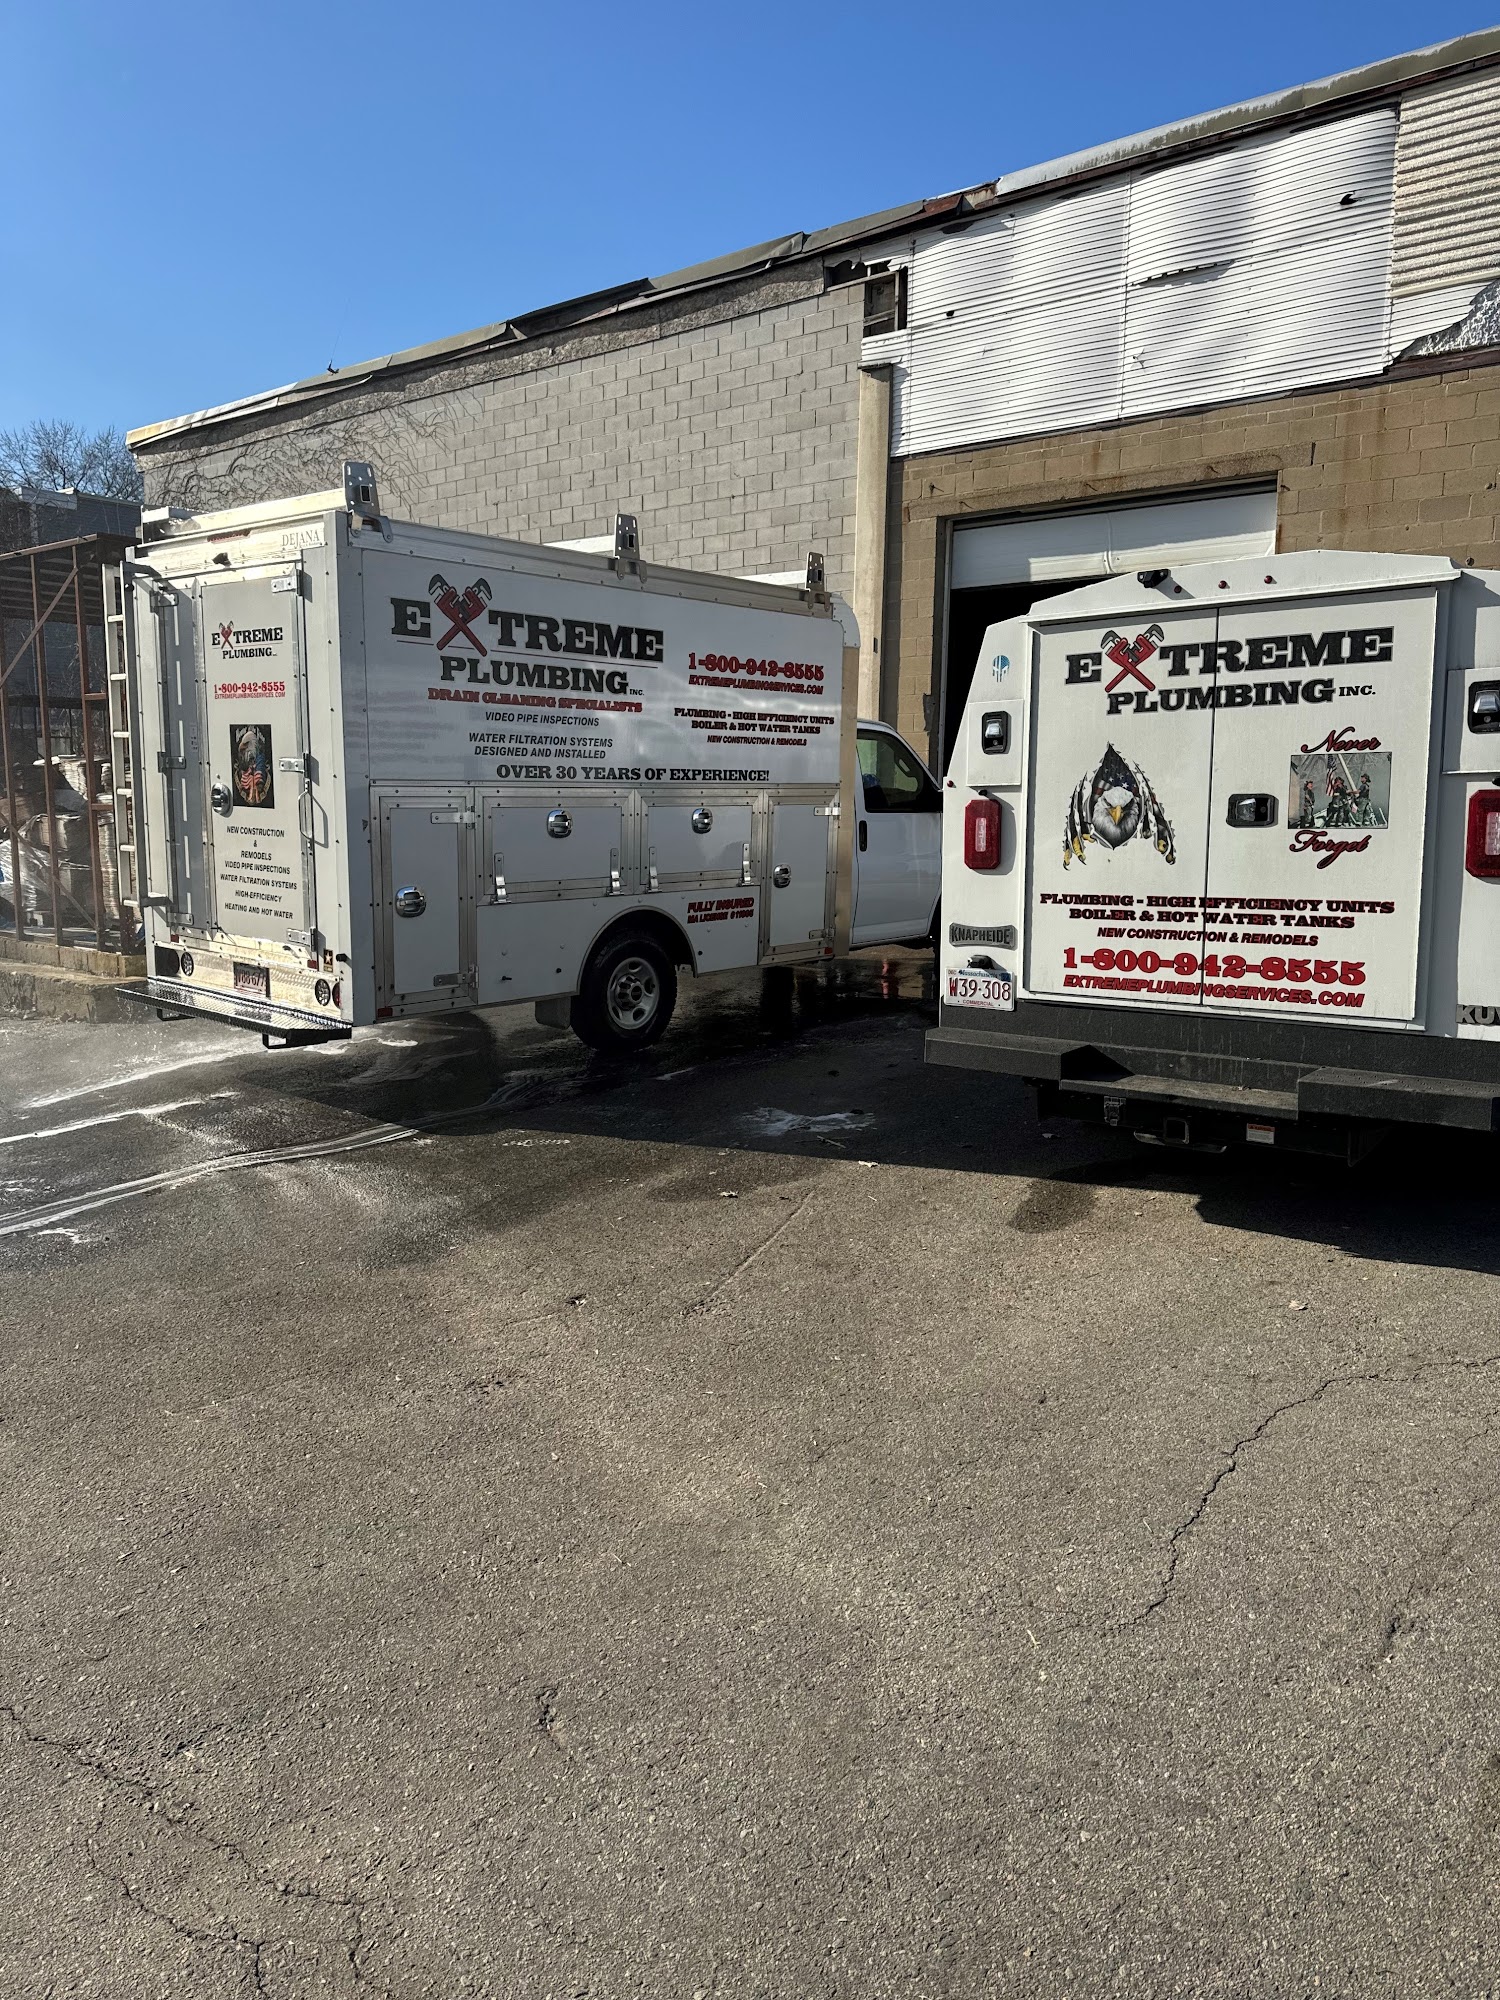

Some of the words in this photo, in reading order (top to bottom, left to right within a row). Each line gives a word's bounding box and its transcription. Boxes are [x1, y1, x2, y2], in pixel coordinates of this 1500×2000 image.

[282, 529, 320, 549] DEJANA
[222, 647, 272, 659] PLUMBING
[688, 652, 824, 681] 1-800-942-8555
[440, 656, 628, 695] PLUMBING
[629, 688, 645, 697] INC.
[688, 675, 823, 695] EXTREMEPLUMBINGSERVICES.COM
[214, 681, 285, 694] 1-800-942-8555
[215, 691, 285, 700] EXTREMEPLUMBINGSERVICES.COM
[1106, 678, 1336, 715] PLUMBING
[1338, 684, 1376, 697] INC.
[428, 688, 480, 703] DRAIN
[481, 692, 557, 708] CLEANING
[557, 698, 642, 713] SPECIALISTS
[485, 711, 515, 722] VIDEO
[516, 713, 539, 724] PIPE
[540, 715, 600, 727] INSPECTIONS
[674, 707, 726, 719] PLUMBING
[732, 711, 756, 720] HIGH
[758, 713, 809, 724] EFFICIENCY
[809, 716, 834, 725] UNITS
[691, 720, 728, 731] BOILER
[729, 723, 736, 731] &
[738, 723, 757, 732] HOT
[759, 724, 791, 733] WATER
[792, 725, 821, 735] TANKS
[469, 732, 506, 744] WATER
[508, 734, 568, 746] FILTRATION
[569, 737, 613, 748] SYSTEMS
[707, 734, 722, 744] NEW
[722, 735, 770, 745] CONSTRUCTION
[776, 737, 807, 747] REMODELS
[1300, 726, 1381, 753] Never
[474, 746, 528, 757] DESIGNED
[530, 747, 552, 758] AND
[553, 748, 606, 759] INSTALLED
[496, 764, 552, 779] OVER
[556, 765, 577, 779] 30
[580, 766, 641, 780] YEARS
[644, 768, 666, 781] OF
[669, 768, 769, 782] EXPERIENCE!
[226, 825, 239, 835] NEW
[239, 826, 285, 838] CONSTRUCTION
[253, 840, 257, 848] &
[1289, 830, 1372, 869] Forget
[240, 850, 272, 861] REMODELS
[224, 860, 241, 870] VIDEO
[241, 861, 254, 871] PIPE
[254, 863, 290, 875] INSPECTIONS
[220, 873, 238, 883] WATER
[238, 875, 270, 887] FILTRATION
[271, 878, 297, 890] SYSTEMS
[235, 889, 282, 903] HIGH-EFFICIENCY
[687, 900, 716, 913] FULLY
[715, 897, 754, 910] INSURED
[1040, 893, 1134, 906] PLUMBING
[1146, 896, 1196, 908] HIGH
[1199, 897, 1323, 911] EFFICIENCY
[1326, 900, 1395, 913] UNITS
[224, 902, 248, 914] HEATING
[248, 905, 260, 915] AND
[261, 907, 273, 917] HOT
[273, 909, 293, 920] WATER
[699, 911, 729, 922] LICENSE
[1069, 908, 1136, 921] BOILER
[1139, 910, 1154, 921] &
[1157, 911, 1199, 923] HOT
[1202, 912, 1277, 926] WATER
[1280, 915, 1355, 929] TANKS
[951, 926, 1010, 945] KNAPHEIDE
[1097, 927, 1127, 938] NEW
[1127, 928, 1228, 942] CONSTRUCTION
[1229, 931, 1239, 943] &
[1241, 932, 1319, 946] REMODELS
[1063, 947, 1366, 986] 1-800-942-8555
[1063, 974, 1366, 1008] EXTREMEPLUMBINGSERVICES.COM
